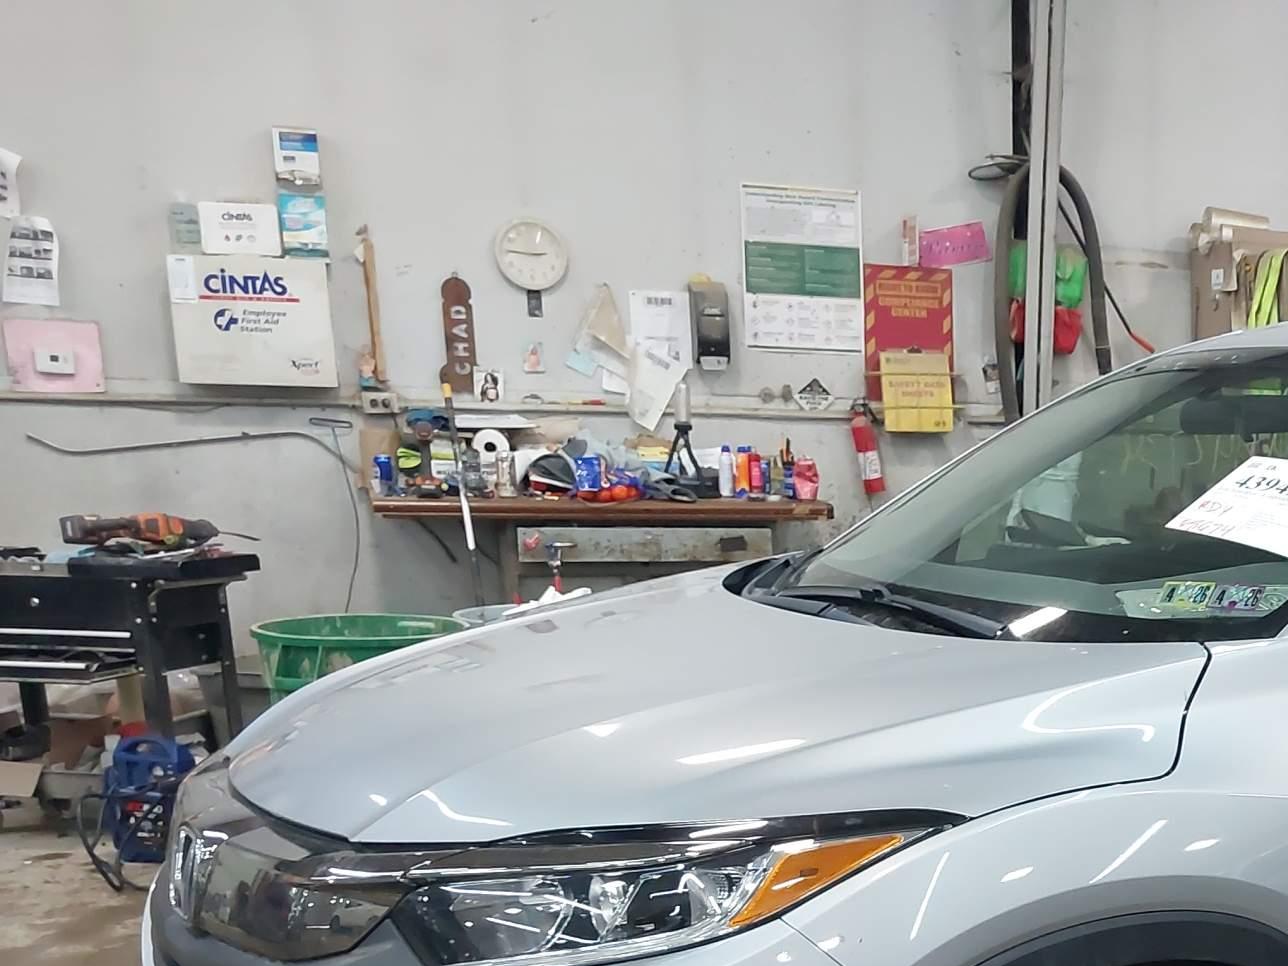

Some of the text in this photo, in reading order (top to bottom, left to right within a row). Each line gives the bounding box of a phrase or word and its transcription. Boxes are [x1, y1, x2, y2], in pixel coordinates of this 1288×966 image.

[242, 309, 287, 317] Employee
[450, 305, 472, 376] CHAD
[1165, 587, 1176, 602] 4
[1216, 589, 1262, 607] 4 26
